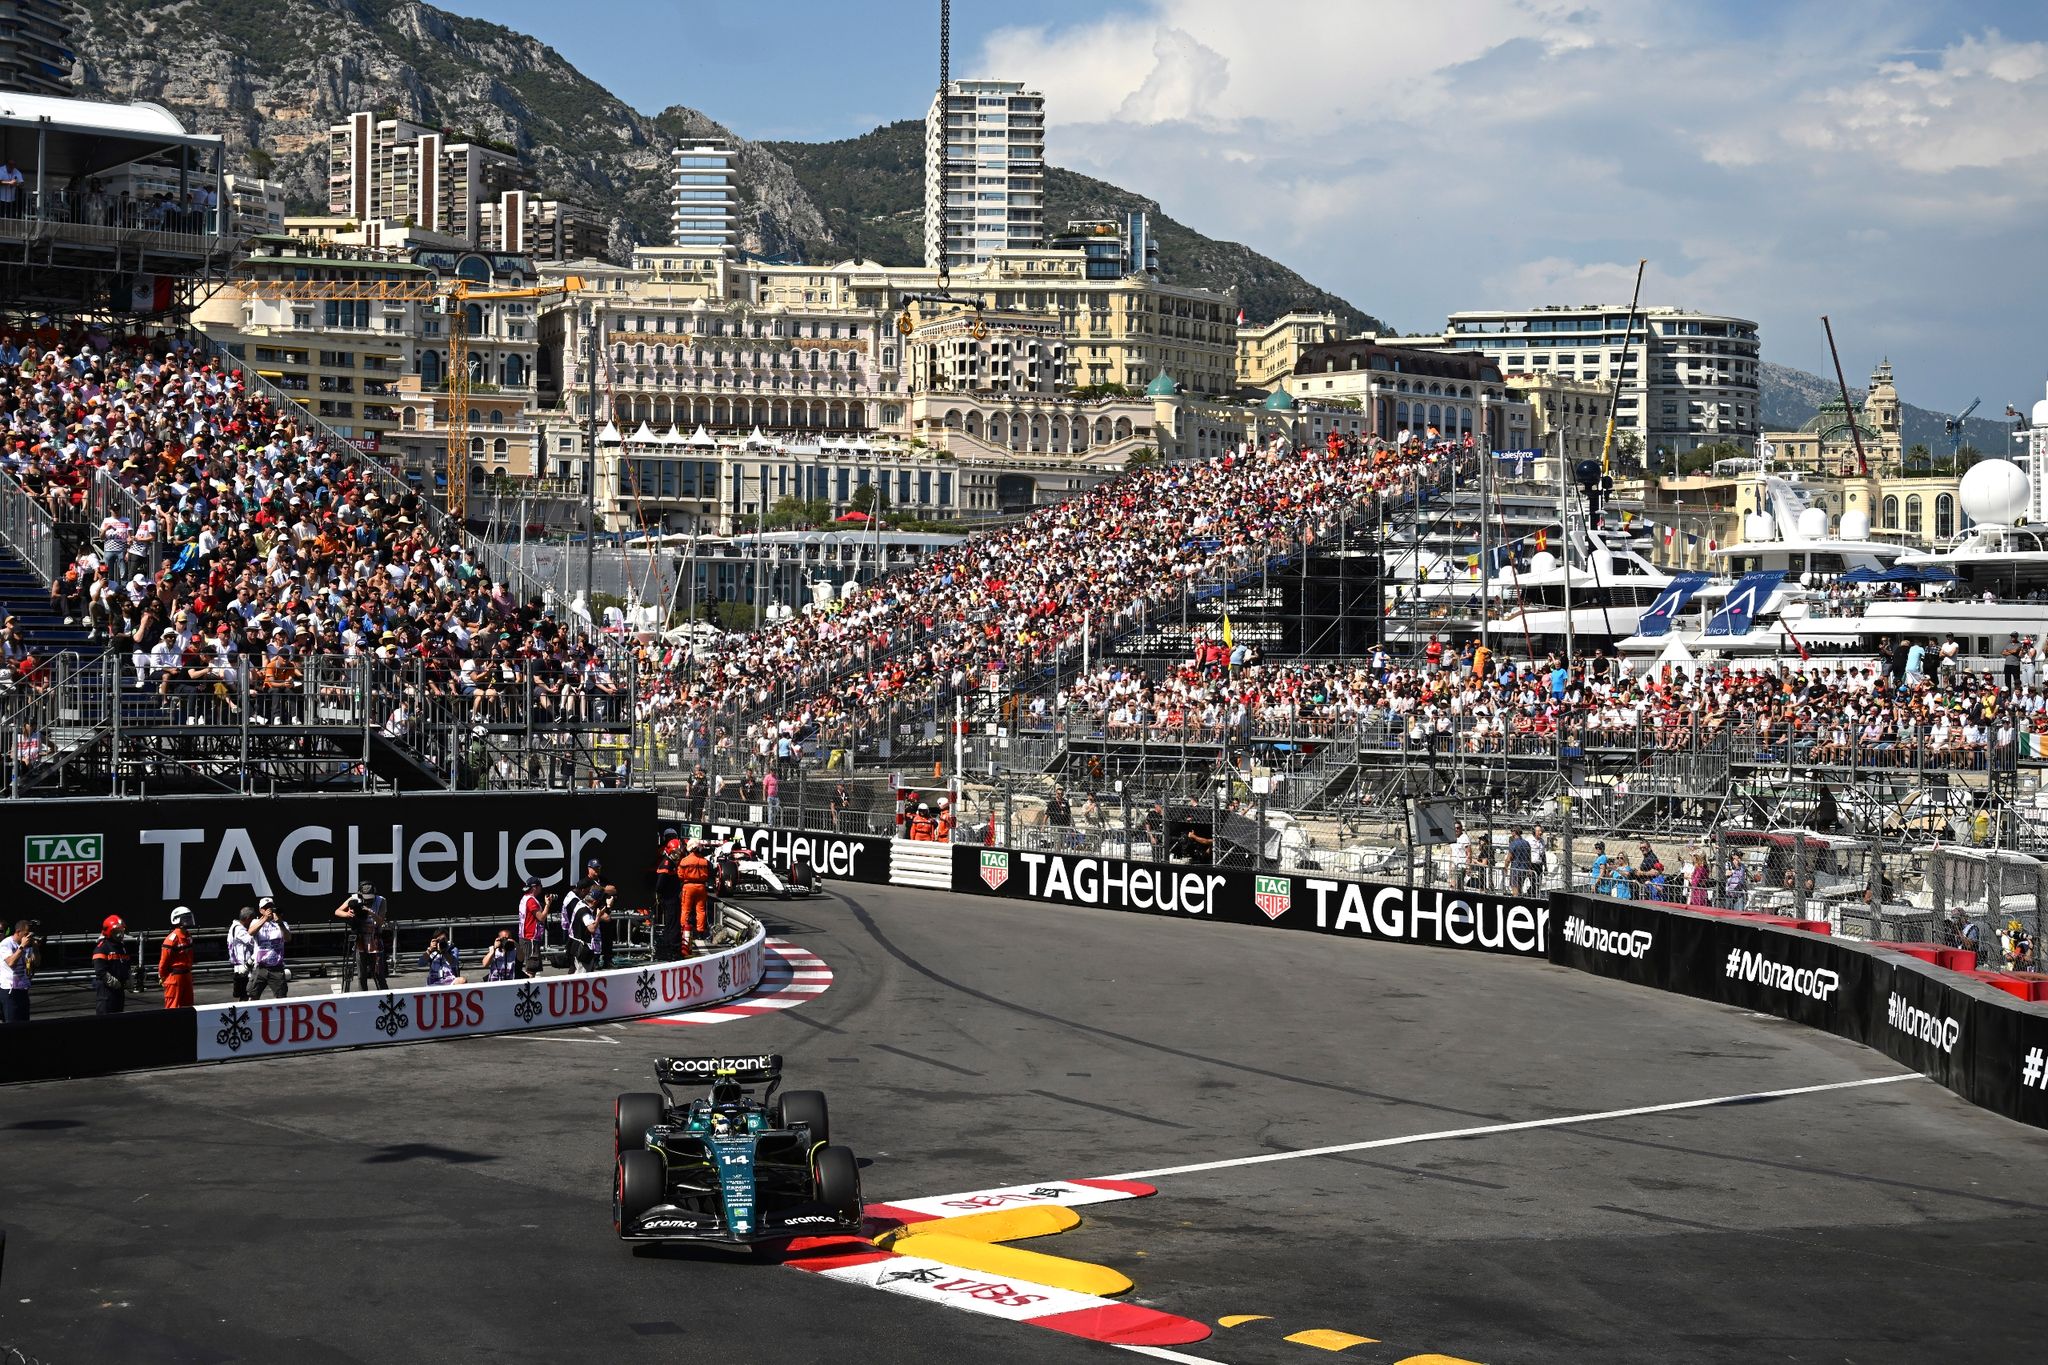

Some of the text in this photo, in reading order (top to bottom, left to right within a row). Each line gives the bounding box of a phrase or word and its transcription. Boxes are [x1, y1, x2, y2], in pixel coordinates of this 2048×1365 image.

[1501, 450, 1533, 460] salesforce
[682, 826, 700, 838] TAG
[41, 839, 96, 861] TAG
[983, 853, 1006, 867] TAG
[28, 864, 100, 896] HEUER
[982, 868, 1007, 887] HEUER
[1259, 879, 1287, 894] TAG
[1257, 895, 1289, 917] HEUER
[1564, 916, 1652, 959] #MonacoGP
[731, 950, 752, 987] UBS
[1727, 948, 1838, 1001] #MonacoGP
[661, 964, 704, 1003] UBS
[550, 979, 608, 1014] UBS
[416, 993, 482, 1029] UBS
[261, 1005, 337, 1044] UBS
[672, 1056, 769, 1077] cognizant
[722, 1156, 749, 1164] 14
[644, 1219, 698, 1229] aramco
[784, 1216, 836, 1226] aramco
[933, 1278, 1049, 1306] UBS
